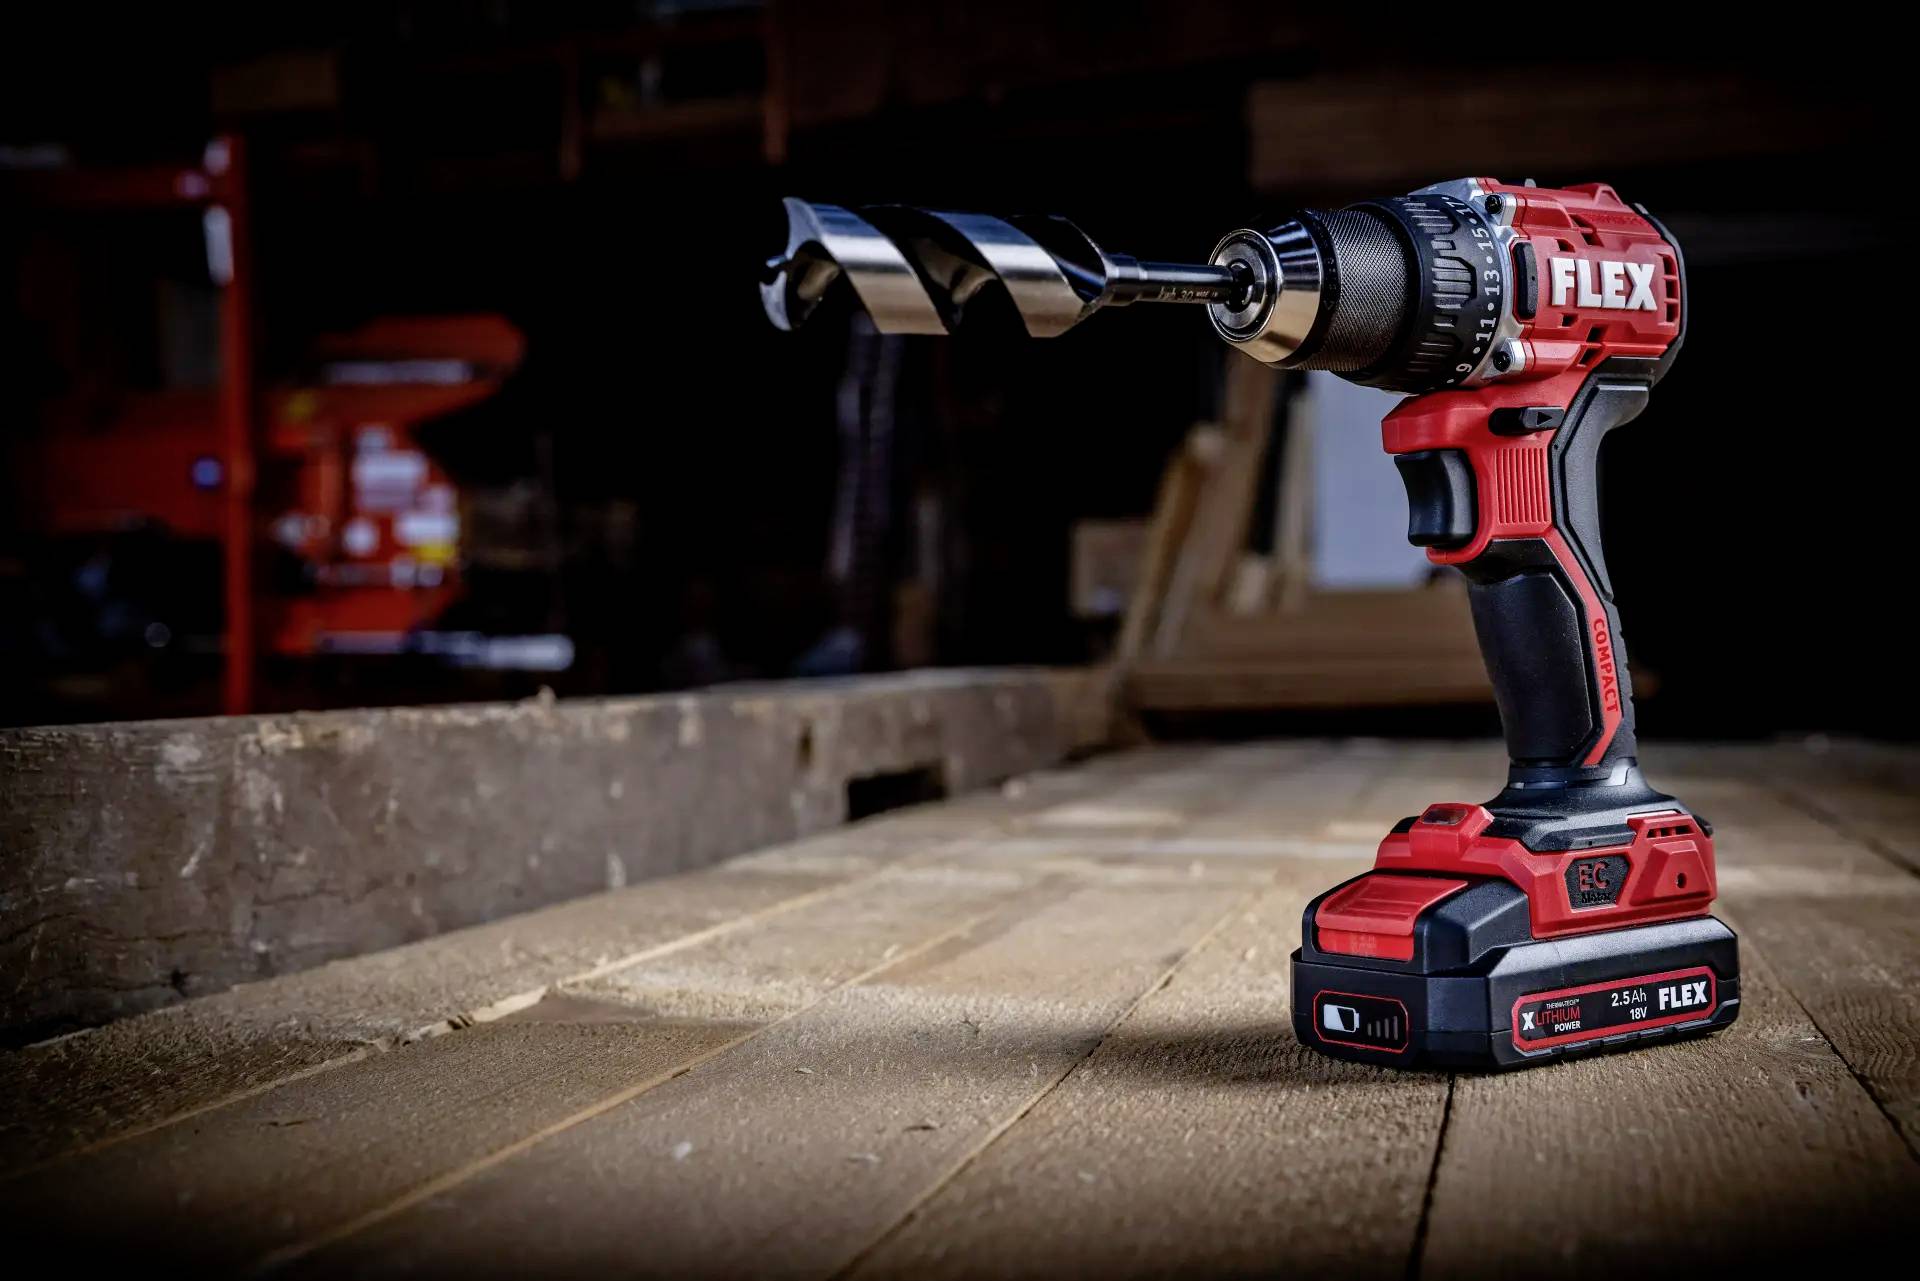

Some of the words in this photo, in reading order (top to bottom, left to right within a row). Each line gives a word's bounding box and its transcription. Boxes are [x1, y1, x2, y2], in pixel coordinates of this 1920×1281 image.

[1472, 228, 1495, 251] 15
[1484, 270, 1501, 297] 13
[1549, 256, 1659, 312] FLEX
[1476, 317, 1497, 342] 11
[1456, 362, 1473, 373] 9
[1593, 618, 1619, 712] COMPACT
[1578, 861, 1610, 891] EC
[1658, 980, 1708, 1011] FLEX
[1554, 1020, 1582, 1033] POWER
[1629, 1006, 1648, 1021] 18V
